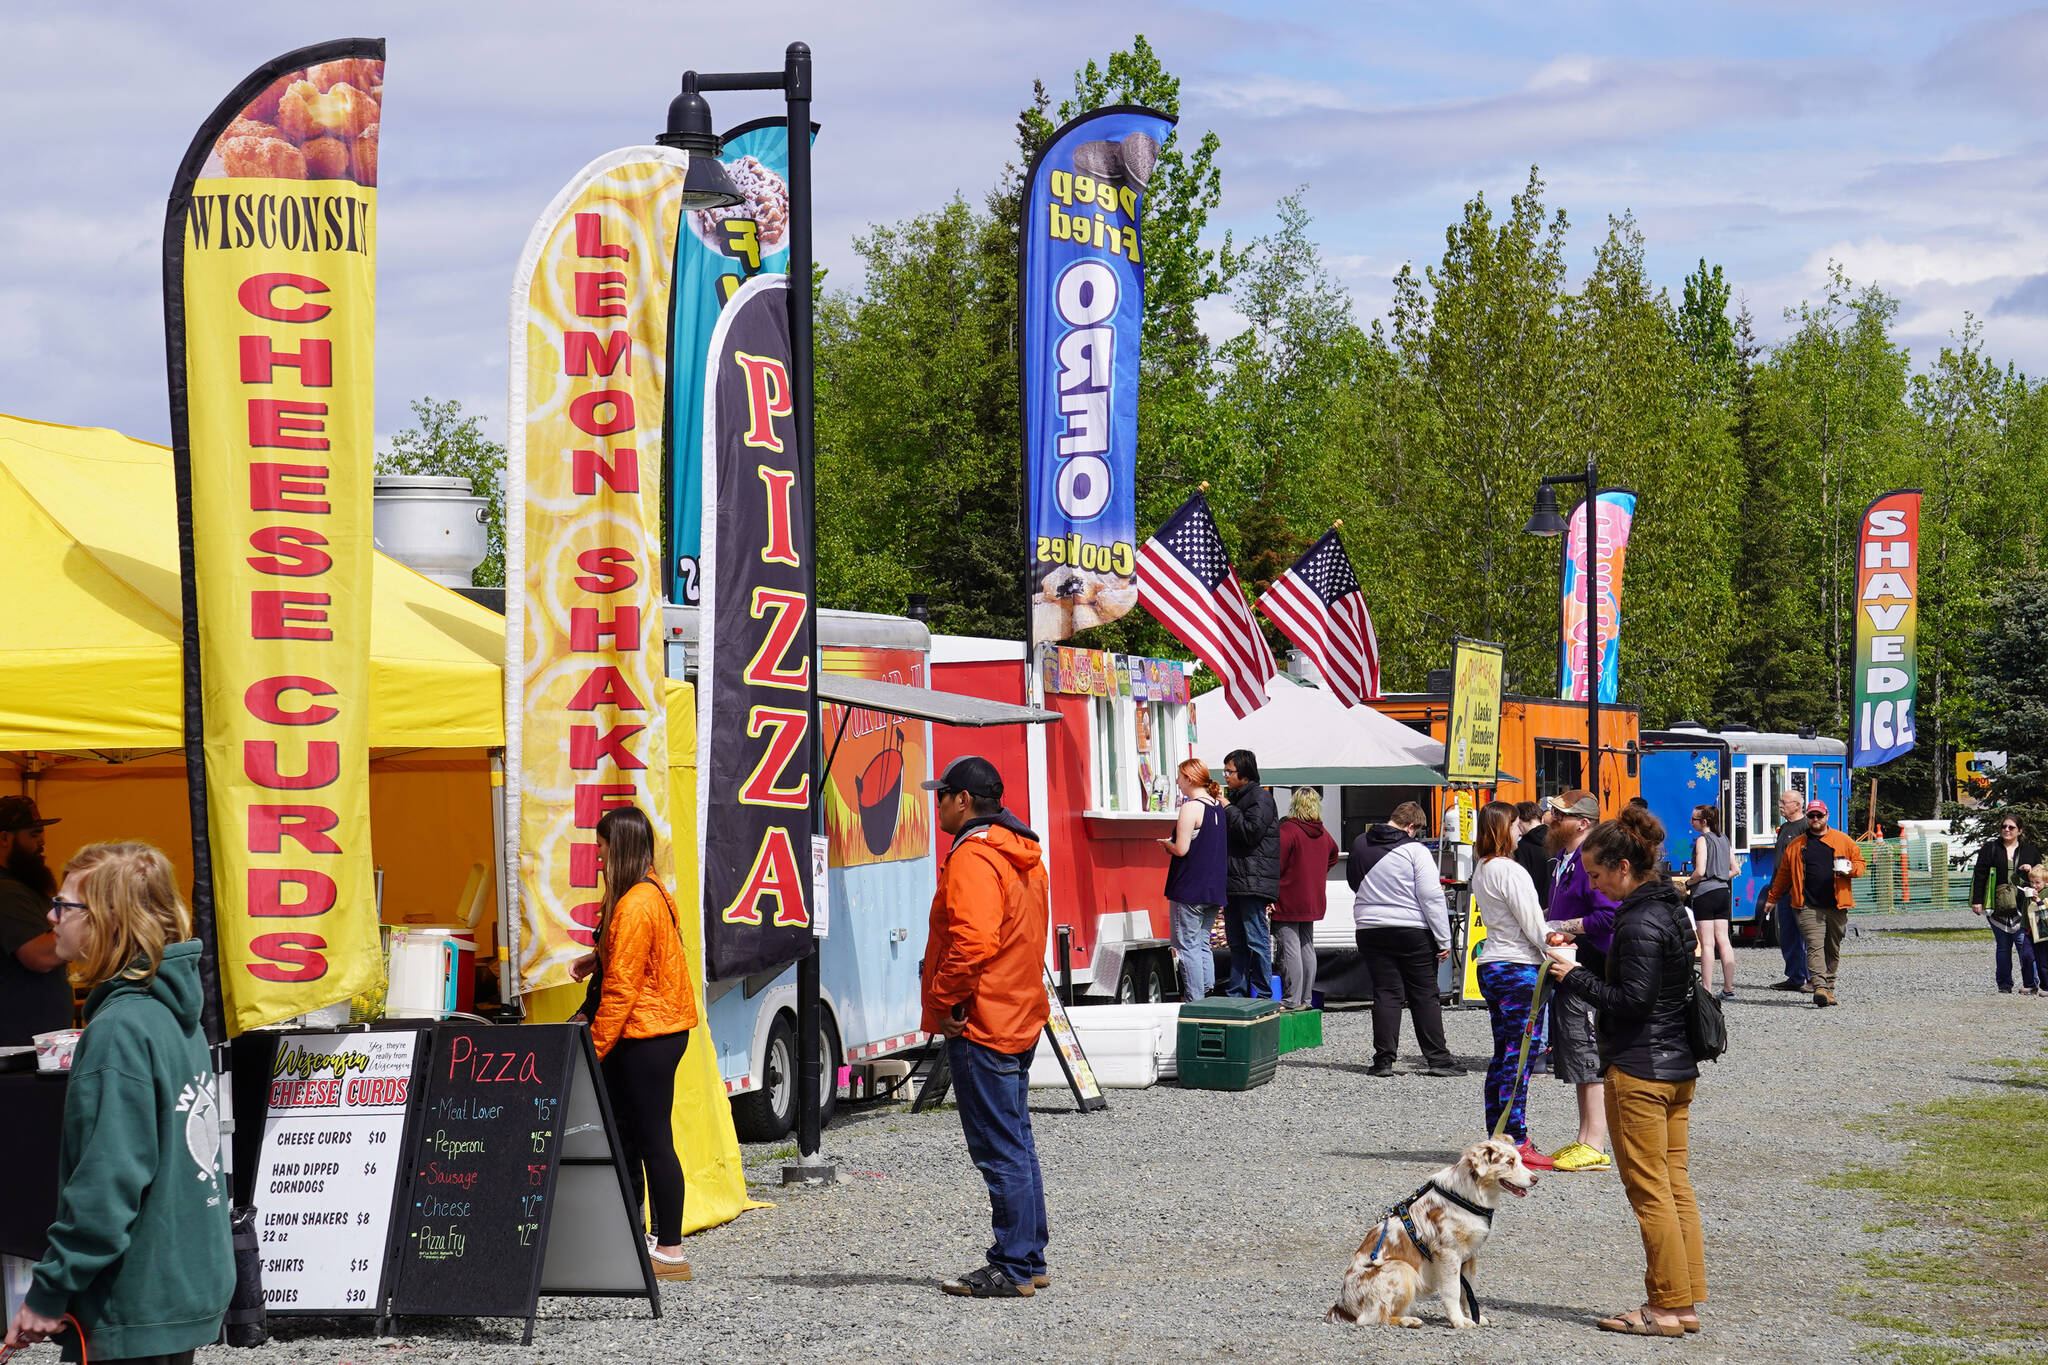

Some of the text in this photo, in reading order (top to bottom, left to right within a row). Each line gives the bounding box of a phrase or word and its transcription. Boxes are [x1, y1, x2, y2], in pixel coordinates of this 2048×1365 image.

[188, 193, 368, 256] WISCONSIN
[564, 213, 640, 496] LEMON
[1862, 509, 1913, 694] SHAVED
[238, 272, 343, 983] CHEESE CURDS
[722, 352, 811, 927] PIZZA
[1473, 701, 1493, 722] Alaska
[1471, 724, 1494, 746] Reindeer
[1860, 698, 1914, 752] ICE
[1468, 747, 1491, 773] Sausage
[273, 1040, 371, 1080] Wisconsin
[375, 1051, 408, 1061] really from
[449, 1035, 543, 1084] Pizza
[268, 1076, 411, 1109] CHEESE CURDS
[438, 1097, 467, 1120] Meat
[471, 1097, 504, 1120] Lover
[277, 1130, 387, 1146] CHEESE CURDS $10
[434, 1129, 486, 1160] Pepperoni
[272, 1161, 377, 1176] HAND DIPPED $6
[427, 1161, 478, 1190] Sausage
[270, 1179, 325, 1194] CORNDOGS
[264, 1211, 370, 1226] LEMON SHAKERS $8
[422, 1195, 471, 1217] Cheese
[262, 1230, 276, 1242] 32
[419, 1225, 446, 1250] Pizza
[446, 1224, 466, 1258] Fry
[259, 1258, 369, 1272] T-SHIRTS $15
[262, 1288, 366, 1303] OODIES $30
